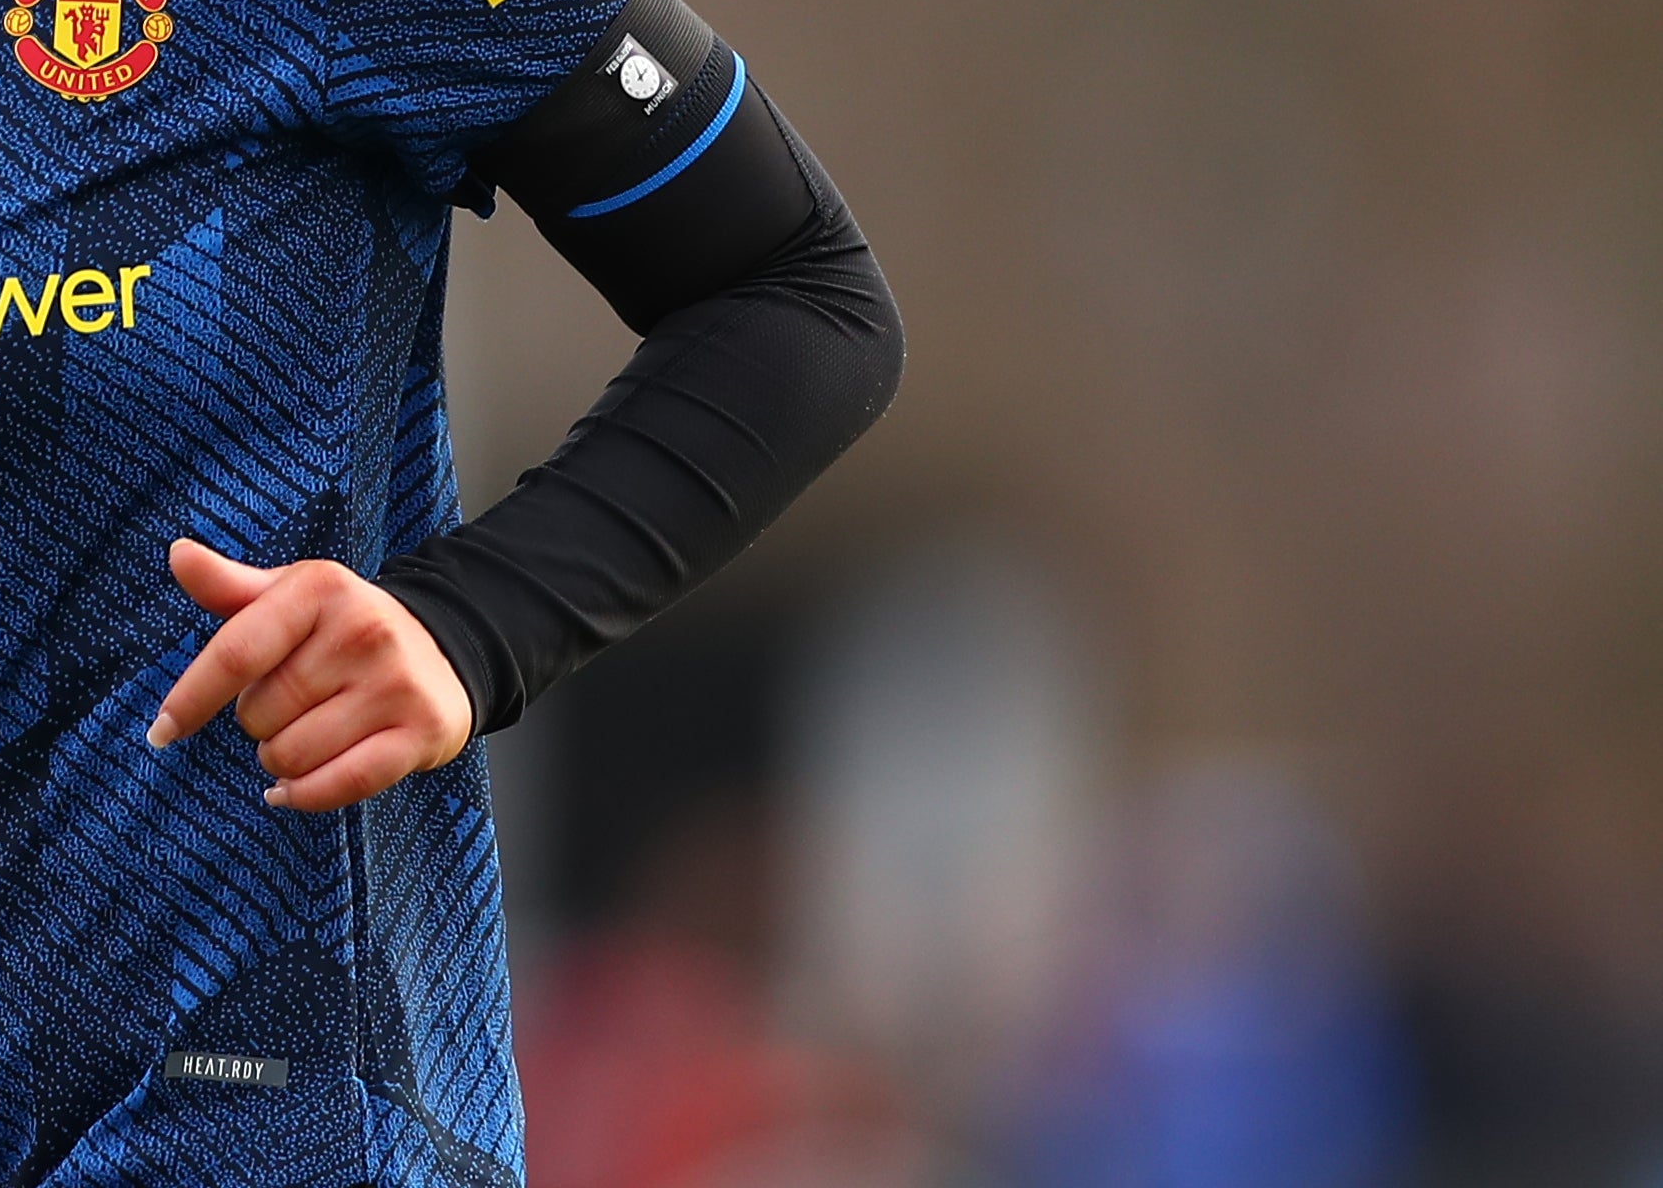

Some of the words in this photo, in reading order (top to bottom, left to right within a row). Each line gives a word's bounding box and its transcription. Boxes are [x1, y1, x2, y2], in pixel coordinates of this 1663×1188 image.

[39, 60, 133, 91] UNITED
[643, 78, 674, 116] MUNICH
[183, 1055, 265, 1081] HEAT.RDY
